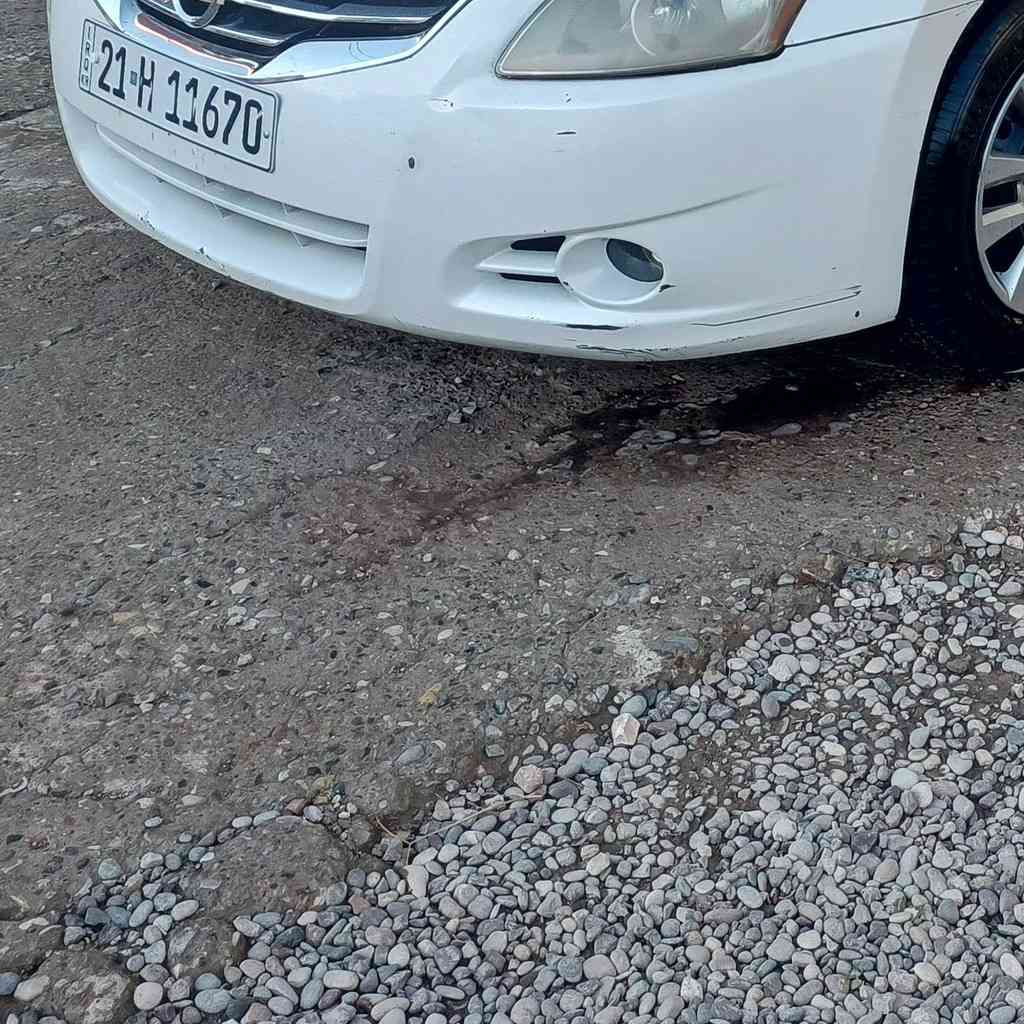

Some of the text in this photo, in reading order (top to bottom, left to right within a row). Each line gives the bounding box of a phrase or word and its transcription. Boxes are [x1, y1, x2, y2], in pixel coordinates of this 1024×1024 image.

[98, 39, 263, 155] 21 H 11670
